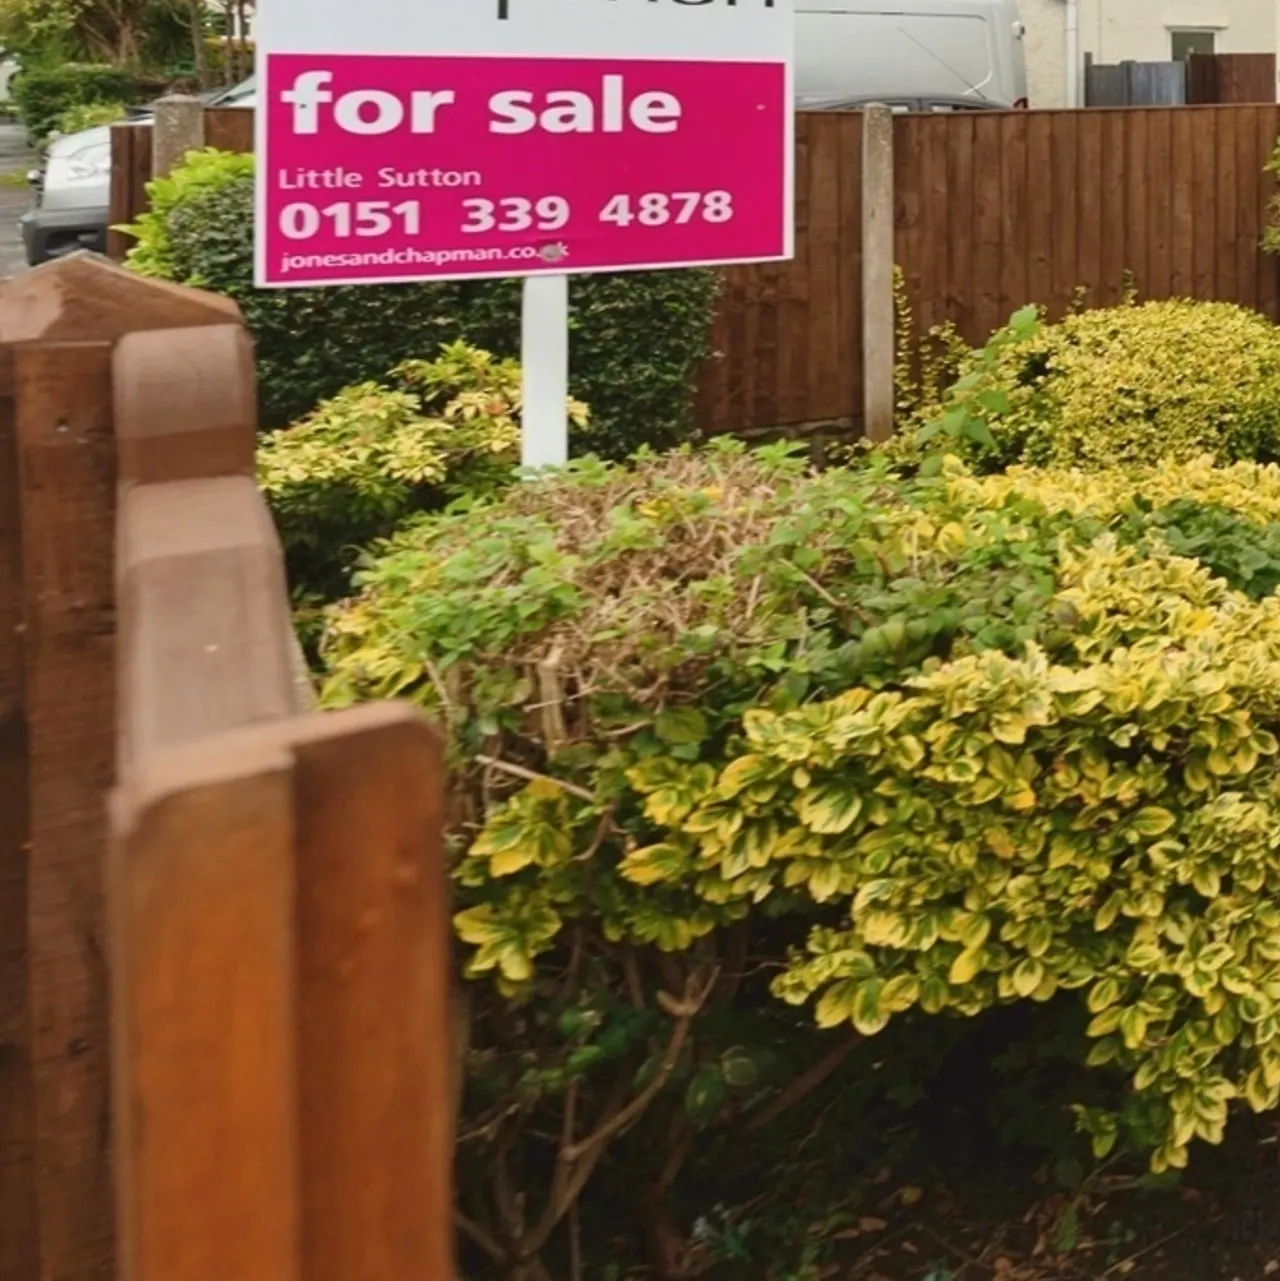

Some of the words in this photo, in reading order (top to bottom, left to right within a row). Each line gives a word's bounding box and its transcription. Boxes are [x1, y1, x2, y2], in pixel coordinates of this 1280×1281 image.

[280, 70, 455, 135] for
[488, 74, 682, 134] sale
[279, 167, 363, 189] Little
[378, 166, 481, 187] Sutton
[279, 200, 420, 239] 0151
[461, 196, 570, 233] 339
[599, 190, 733, 227] 4878
[280, 241, 570, 273] jonesandchapman.co.k
